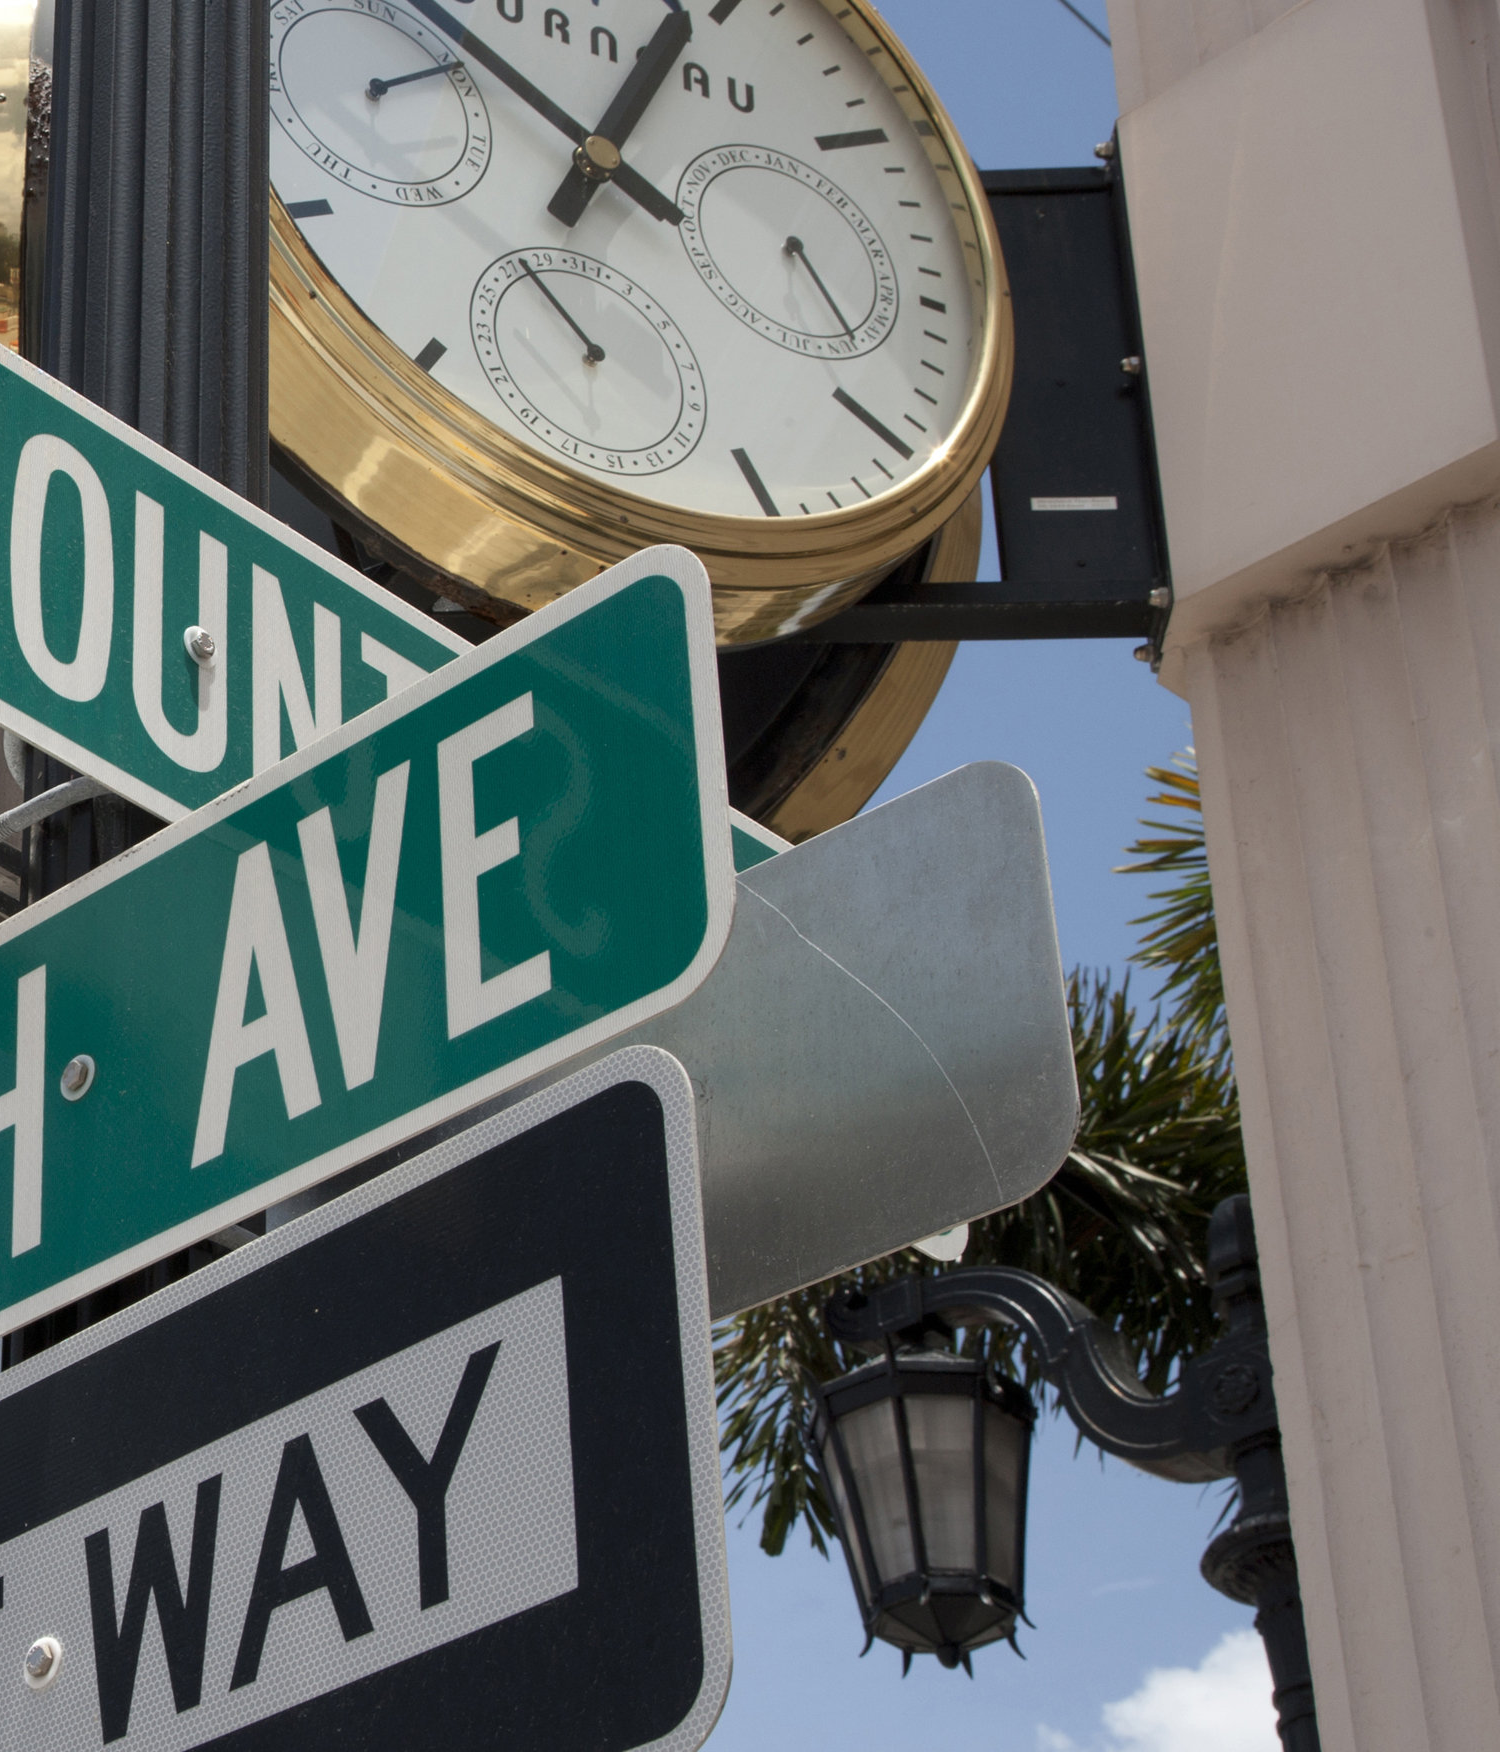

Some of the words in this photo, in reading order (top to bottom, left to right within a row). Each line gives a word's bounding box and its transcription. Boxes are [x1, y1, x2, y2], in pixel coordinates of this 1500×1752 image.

[354, 0, 396, 21] SUN
[306, 142, 352, 182] THU
[465, 134, 486, 172] TUE
[717, 150, 751, 166] DEC
[764, 153, 799, 175] JAN
[687, 161, 711, 192] NOV
[396, 186, 444, 202] WED
[815, 179, 848, 209] FEB
[682, 196, 697, 233] OCT
[853, 218, 884, 259] MAR
[499, 259, 519, 280] 27
[531, 253, 553, 267] 29
[691, 247, 718, 280] SEP
[479, 284, 497, 307] 25
[621, 283, 633, 296] 3
[878, 270, 894, 307] APR
[726, 294, 762, 325] AUG
[477, 322, 492, 344] 23
[657, 319, 671, 331] 5
[864, 312, 890, 343] MAY
[776, 329, 810, 352] JUL
[827, 338, 858, 354] JUN
[489, 366, 509, 385] 21
[681, 361, 695, 372] 7
[520, 406, 539, 426] 19
[688, 401, 701, 413] 9
[560, 437, 579, 455] 17
[674, 430, 691, 449] 11
[606, 454, 624, 469] 15
[646, 450, 665, 468] 13
[190, 690, 552, 1169] AVE
[83, 1338, 503, 1745] WAY
